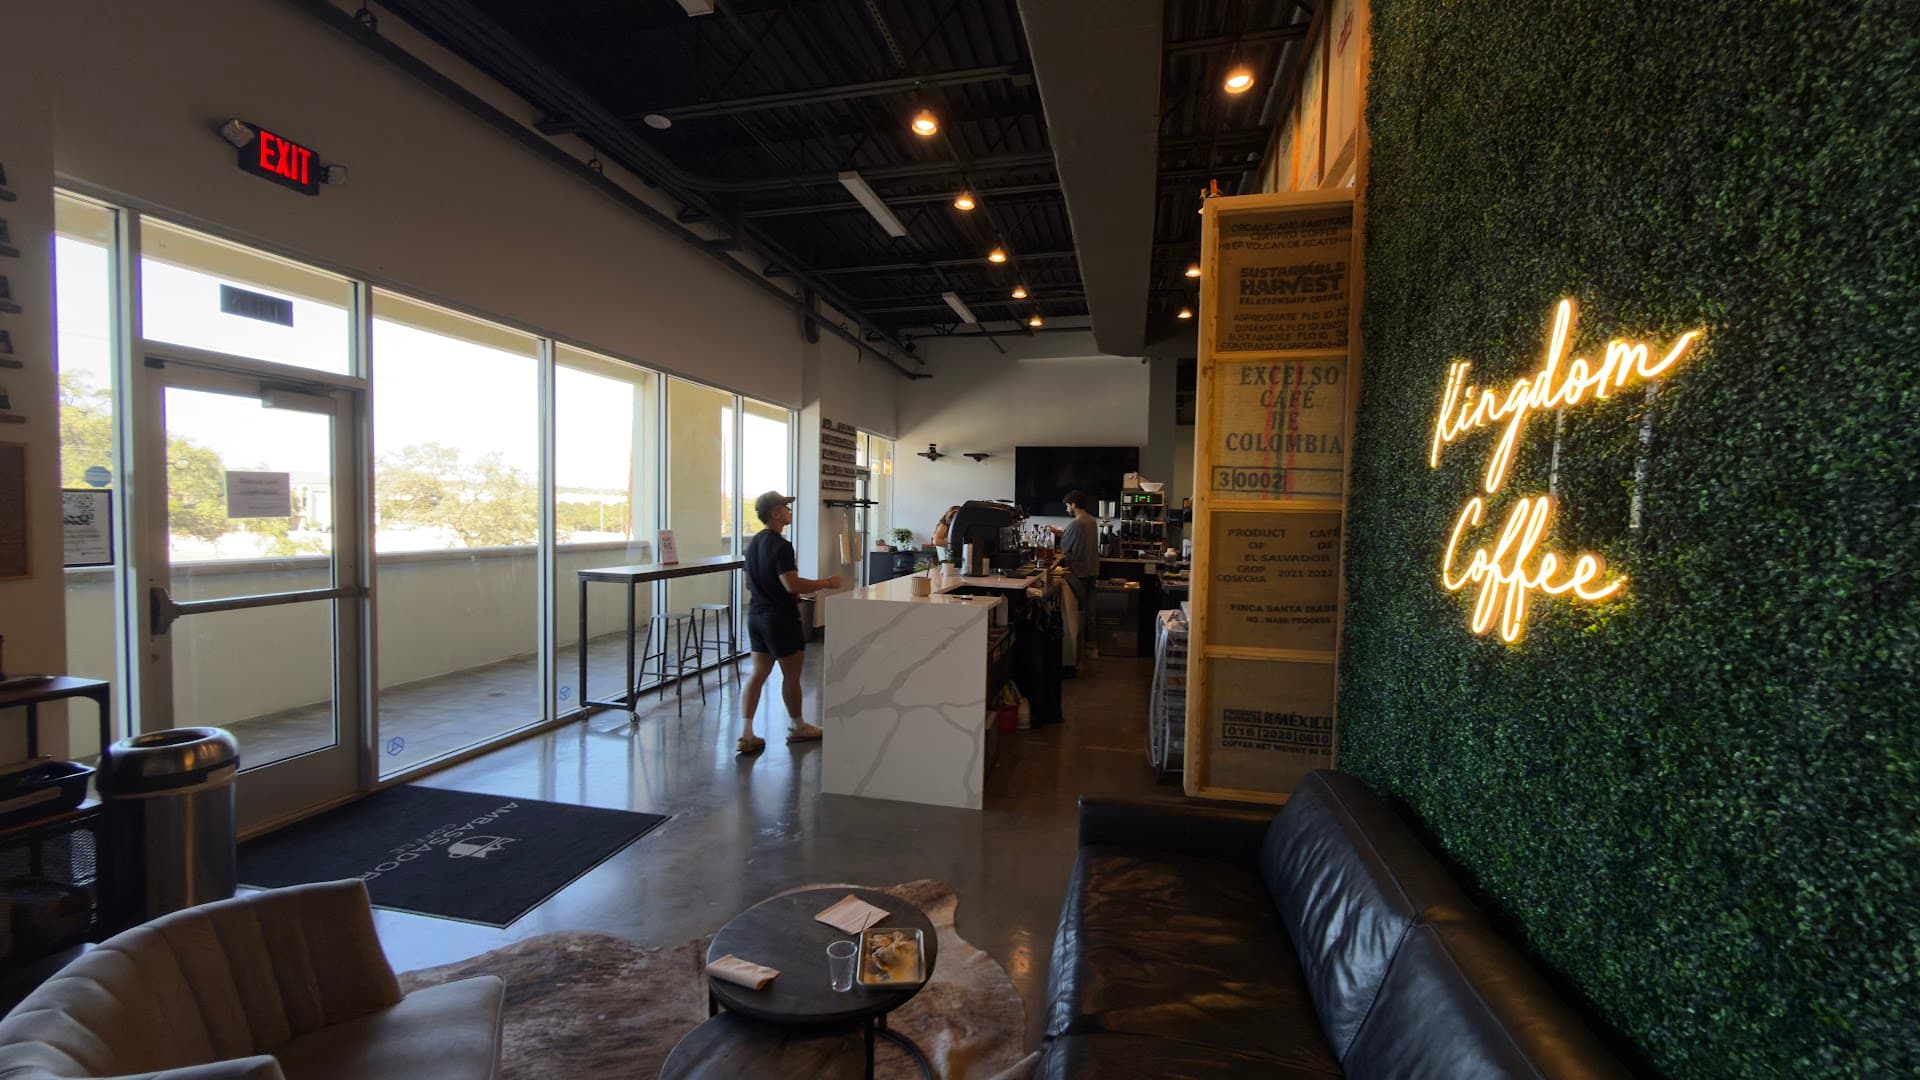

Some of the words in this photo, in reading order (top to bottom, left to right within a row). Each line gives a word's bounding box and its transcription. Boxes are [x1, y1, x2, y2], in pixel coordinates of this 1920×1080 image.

[259, 130, 312, 185] EXIT
[1239, 273, 1344, 296] HARVEST
[1310, 293, 1344, 303] COFFEE
[1240, 366, 1339, 386] EXCELSO
[1260, 385, 1314, 409] CAFÉ
[1271, 411, 1300, 431] DE
[1225, 433, 1344, 454] COLOMBIA
[1227, 528, 1287, 538] PRODUCT
[1248, 541, 1265, 550] OF
[1317, 541, 1333, 550] DE
[1244, 554, 1258, 562] EL
[1261, 554, 1330, 563] SALVADOR
[1236, 565, 1266, 573] CROP
[1443, 496, 1628, 642] Coffee
[1216, 574, 1267, 583] COSECHA
[1230, 603, 1263, 612] FINCA
[1265, 604, 1302, 613] SANTA
[1222, 740, 1253, 749] COFFEE
[357, 802, 519, 881] AMBASSADOR
